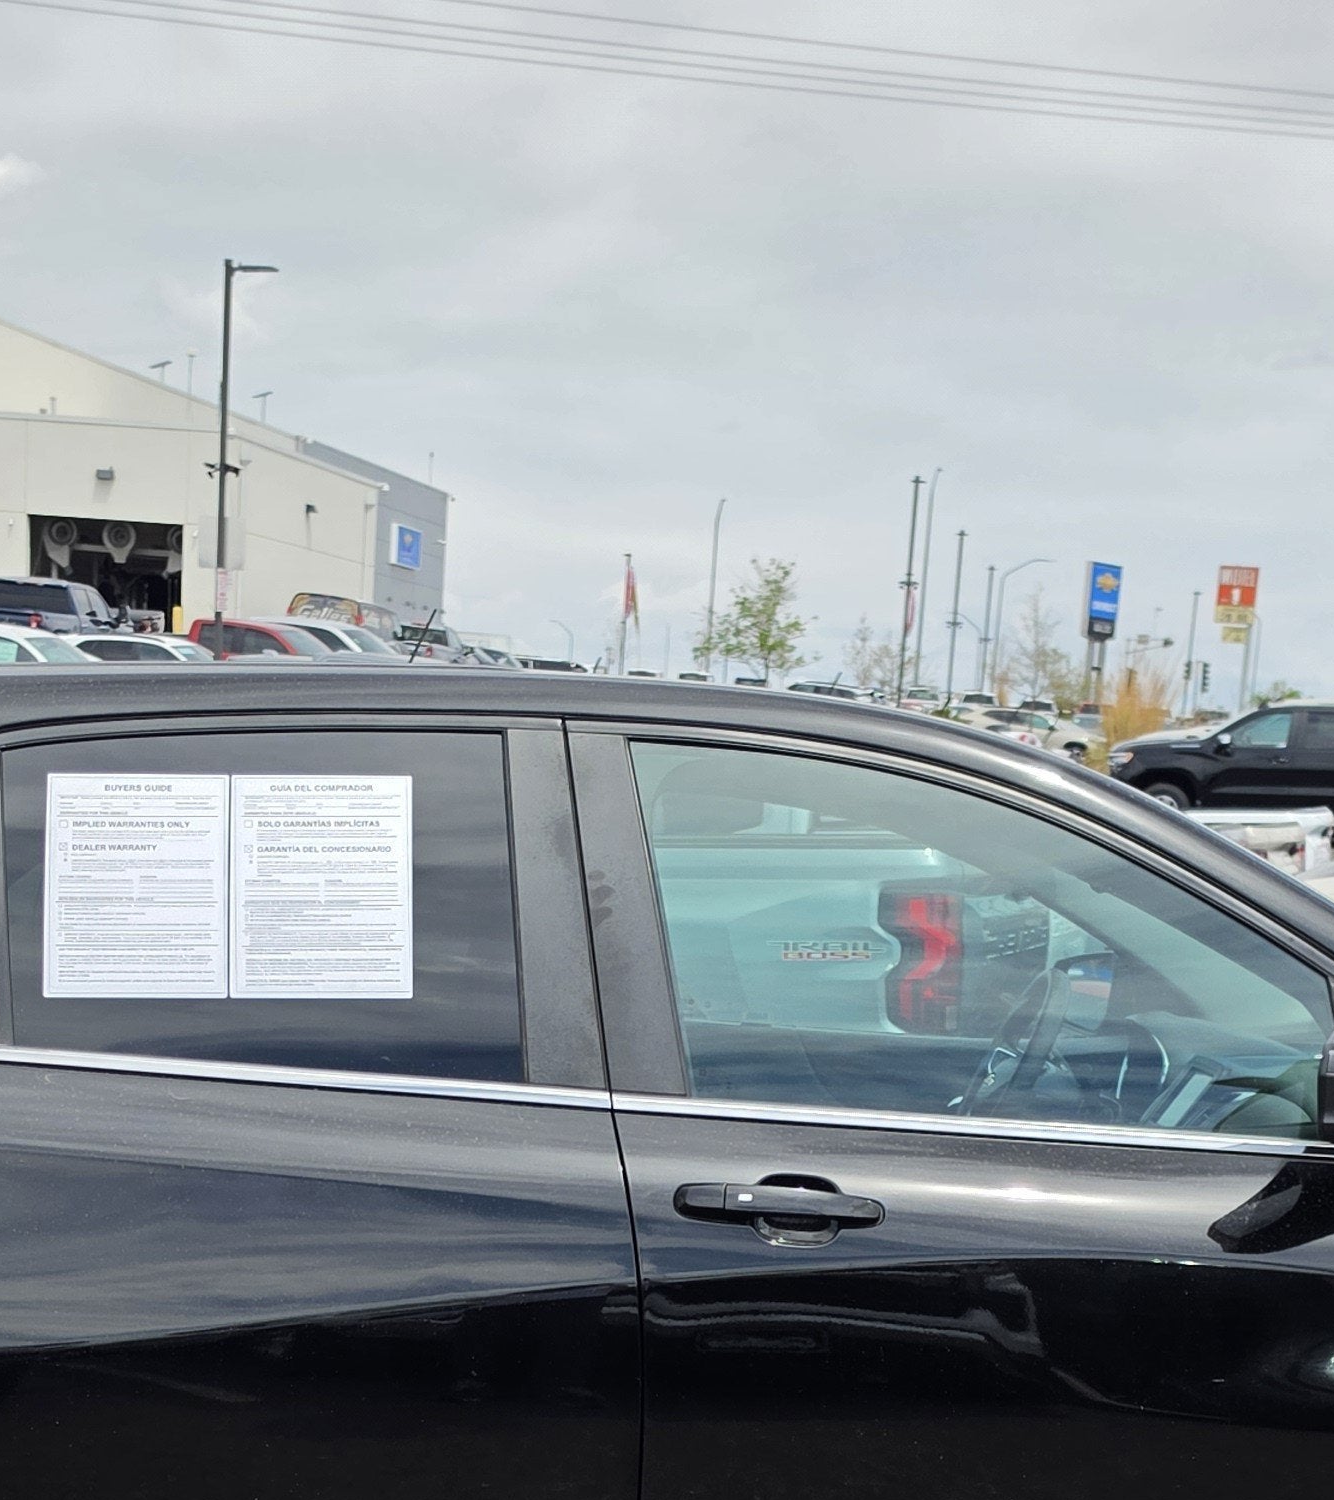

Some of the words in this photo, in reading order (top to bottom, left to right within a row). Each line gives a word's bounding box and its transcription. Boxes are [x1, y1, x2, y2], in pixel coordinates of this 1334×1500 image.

[104, 784, 142, 792] BUYERS
[144, 784, 173, 792] GUIDE
[294, 784, 312, 792] DEL
[314, 784, 374, 792] COMPRADOR
[257, 820, 281, 828] SOLO
[283, 819, 332, 828] GARANTÍAS
[334, 819, 380, 828] IMPLÍCITAS
[257, 844, 301, 853] GARANTÍA
[782, 951, 871, 961] BOSS
